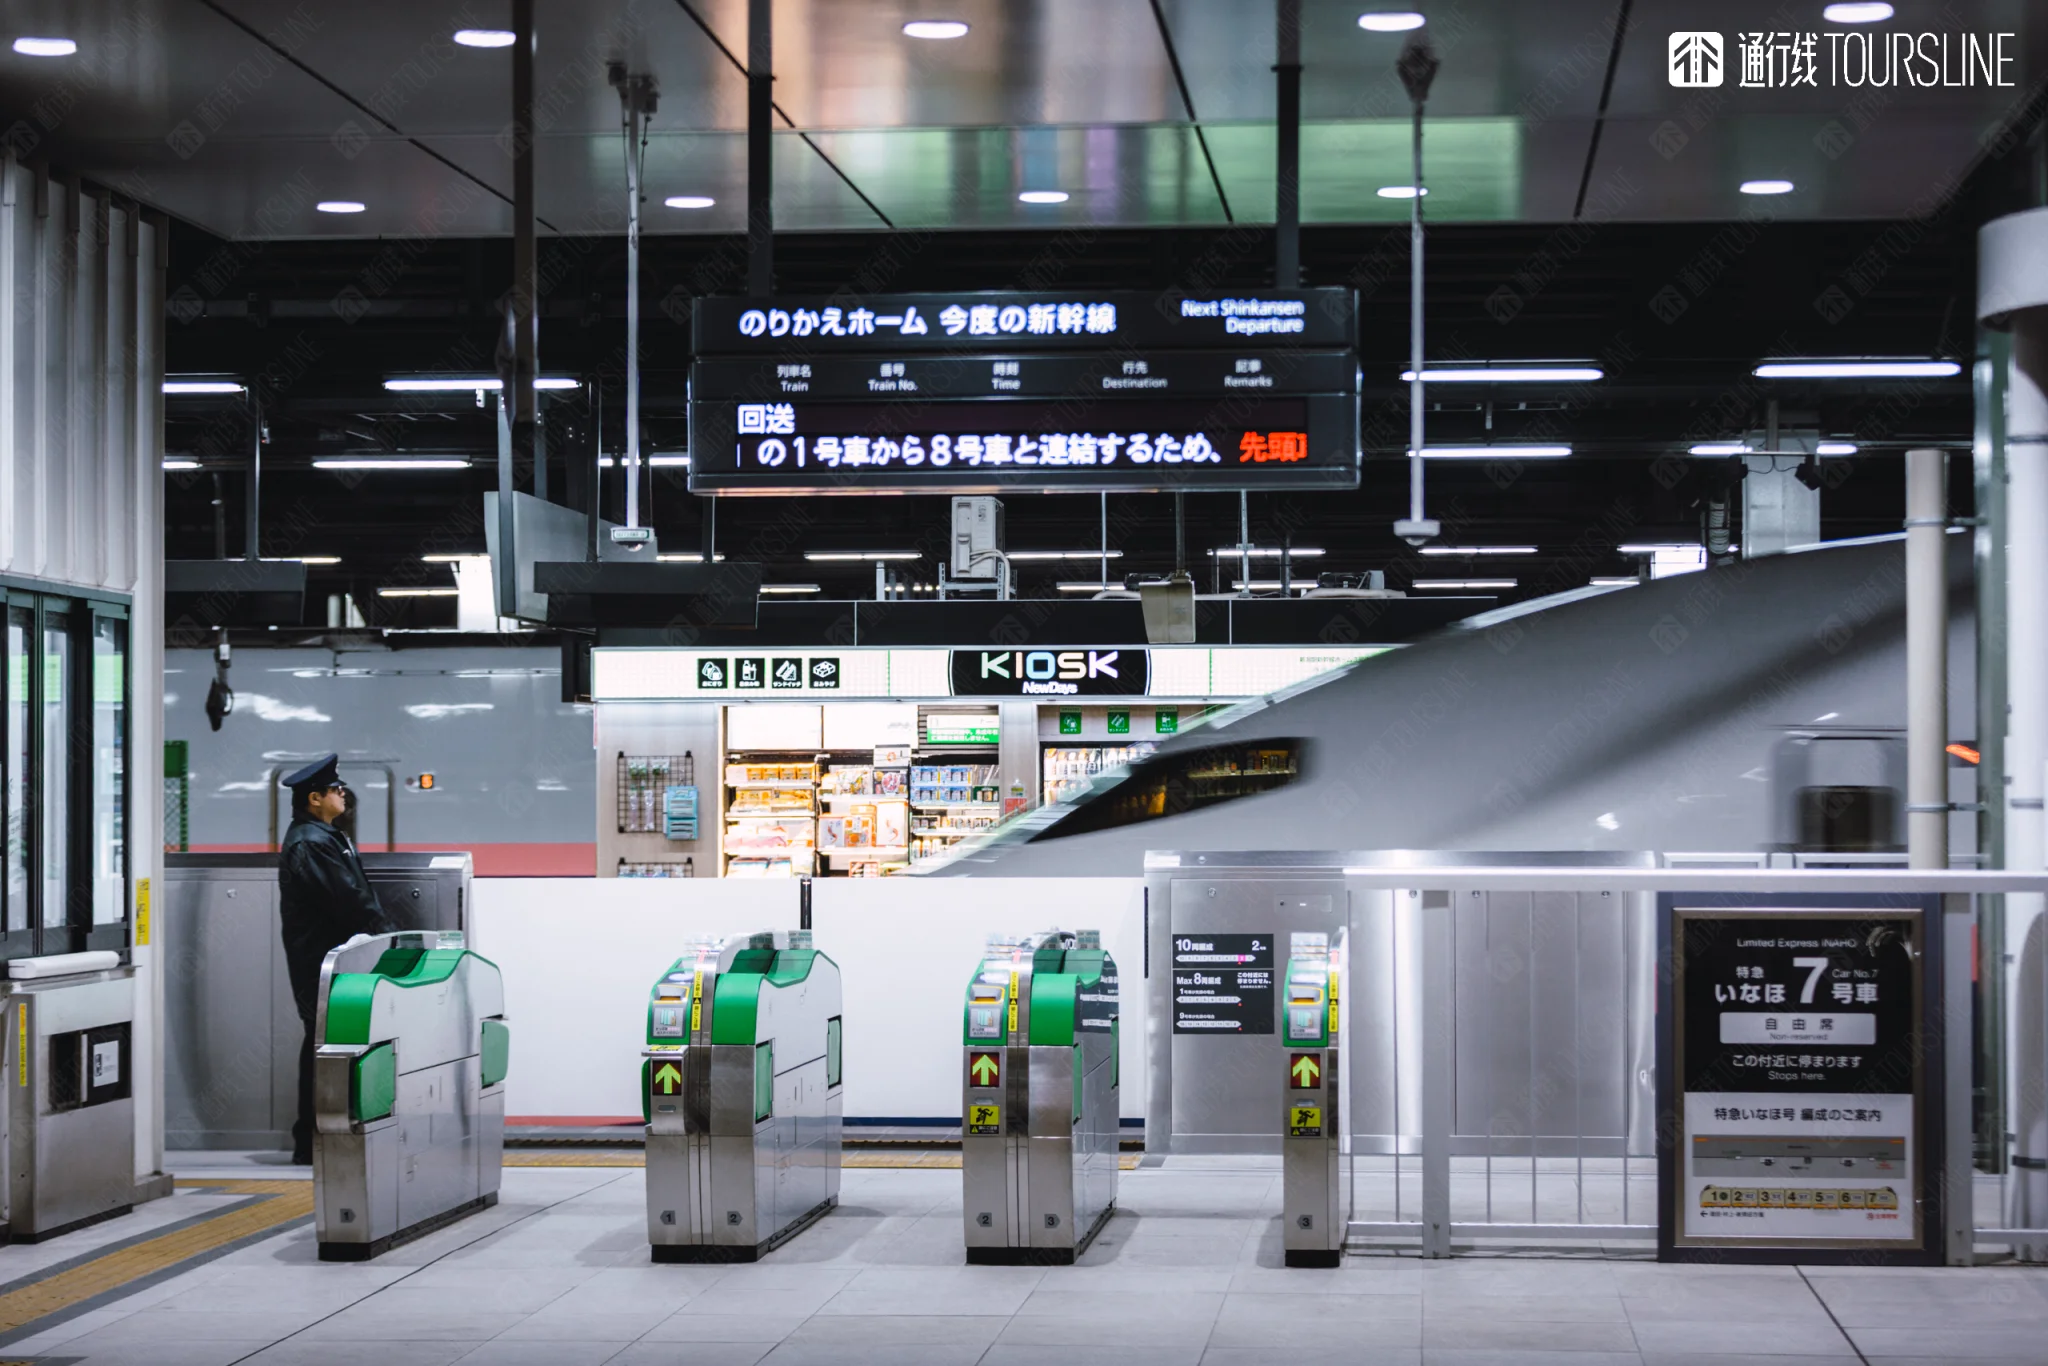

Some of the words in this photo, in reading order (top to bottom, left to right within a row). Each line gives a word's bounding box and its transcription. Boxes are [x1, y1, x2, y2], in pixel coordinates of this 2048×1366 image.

[1181, 300, 1219, 316] Next
[1221, 299, 1305, 316] Shinkansen
[739, 306, 928, 337] のりかえホーム
[939, 303, 1117, 335] 今度の新幹線
[1226, 317, 1304, 335] Departure
[777, 364, 812, 378] 列車名
[880, 363, 905, 377] 番号
[1122, 361, 1148, 375] 行先
[780, 381, 809, 392] Train
[868, 380, 898, 392] Train
[899, 380, 918, 391] No.
[992, 379, 1020, 391] Time
[1102, 377, 1168, 389] Destination
[1224, 376, 1273, 388] Remarks
[737, 398, 795, 434] 回送
[981, 651, 1118, 680] KIOSK
[1022, 681, 1078, 695] NewDays
[1737, 938, 1775, 948] Limited
[1778, 938, 1819, 949] Express
[1736, 966, 1764, 979] 特急
[1832, 968, 1850, 979] Car
[1177, 977, 1192, 986] Max
[1714, 983, 1786, 1004] いなほ
[1793, 957, 1829, 1004] 7
[1831, 982, 1878, 1004] 号車
[1769, 1032, 1828, 1041] Non-reserved
[1732, 1054, 1862, 1069] この付近に停まります
[1768, 1071, 1798, 1082] Stops
[1801, 1071, 1827, 1081] here.
[1714, 1108, 1796, 1122] 特急いなほ号
[1711, 1191, 1718, 1202] 1
[1734, 1191, 1743, 1202] 2
[1761, 1191, 1769, 1202] 3
[1787, 1191, 1796, 1202] 4
[1815, 1191, 1823, 1202] 5
[1841, 1191, 1850, 1202] 6
[1868, 1191, 1877, 1202] 7
